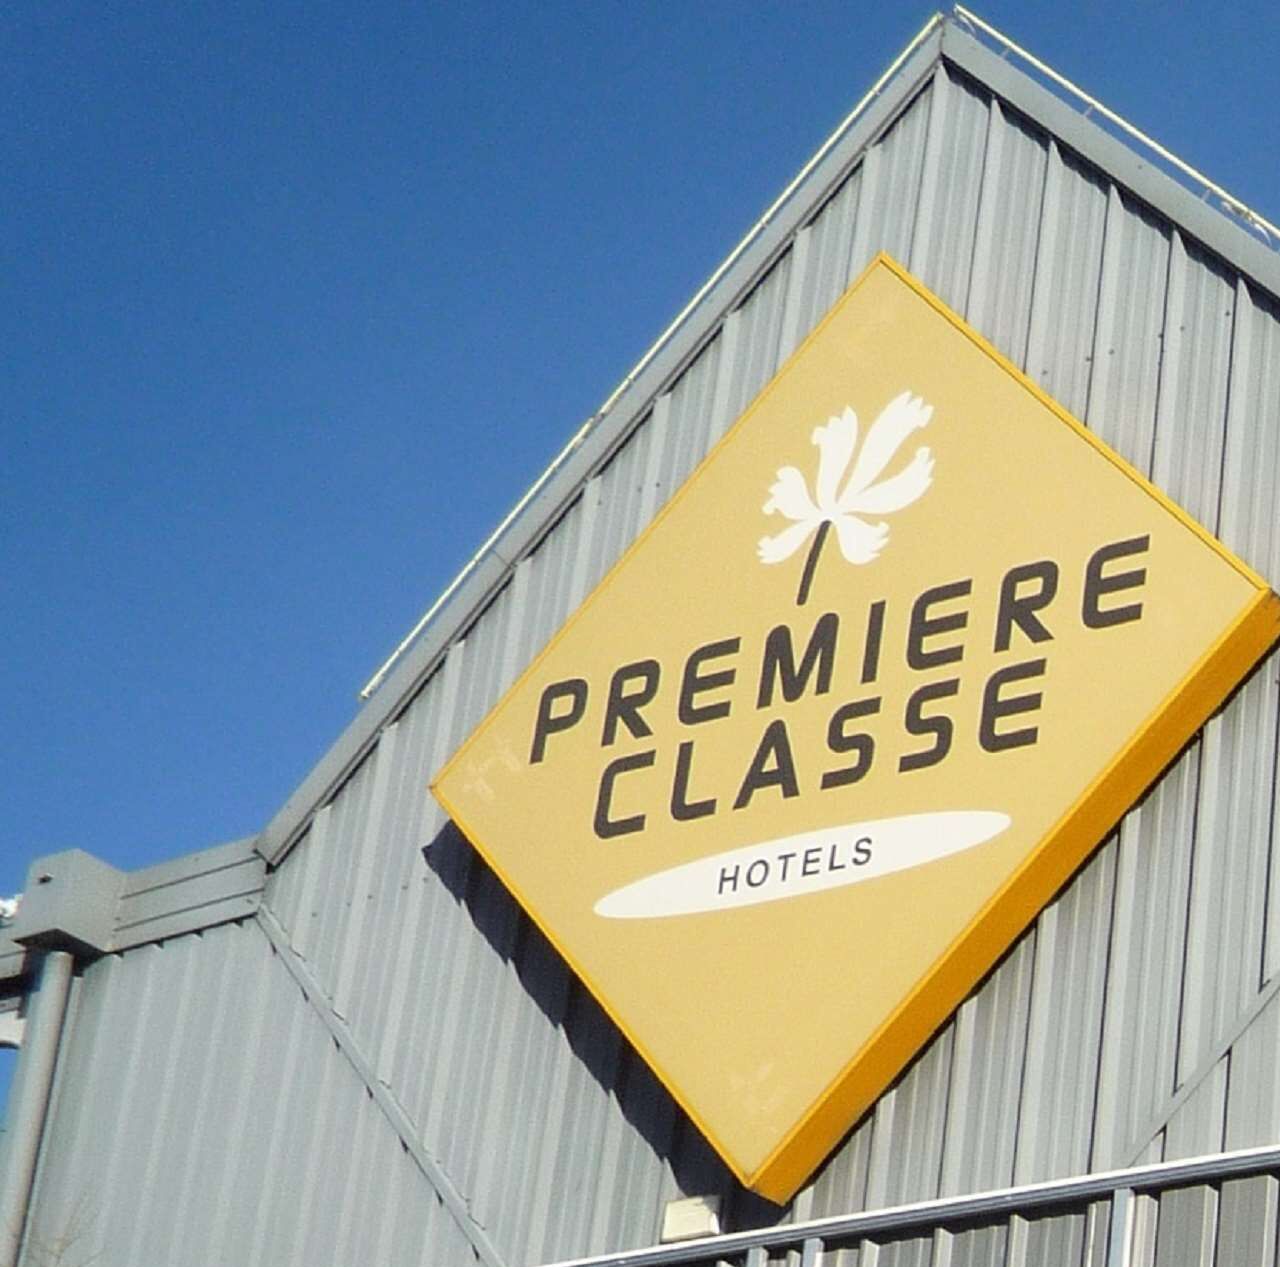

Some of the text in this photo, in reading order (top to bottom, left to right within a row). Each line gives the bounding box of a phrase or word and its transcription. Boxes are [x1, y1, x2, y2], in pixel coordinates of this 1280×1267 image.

[530, 535, 1151, 764] PREMIERE
[594, 658, 1046, 839] CLASSE
[718, 838, 873, 894] HOTELS
